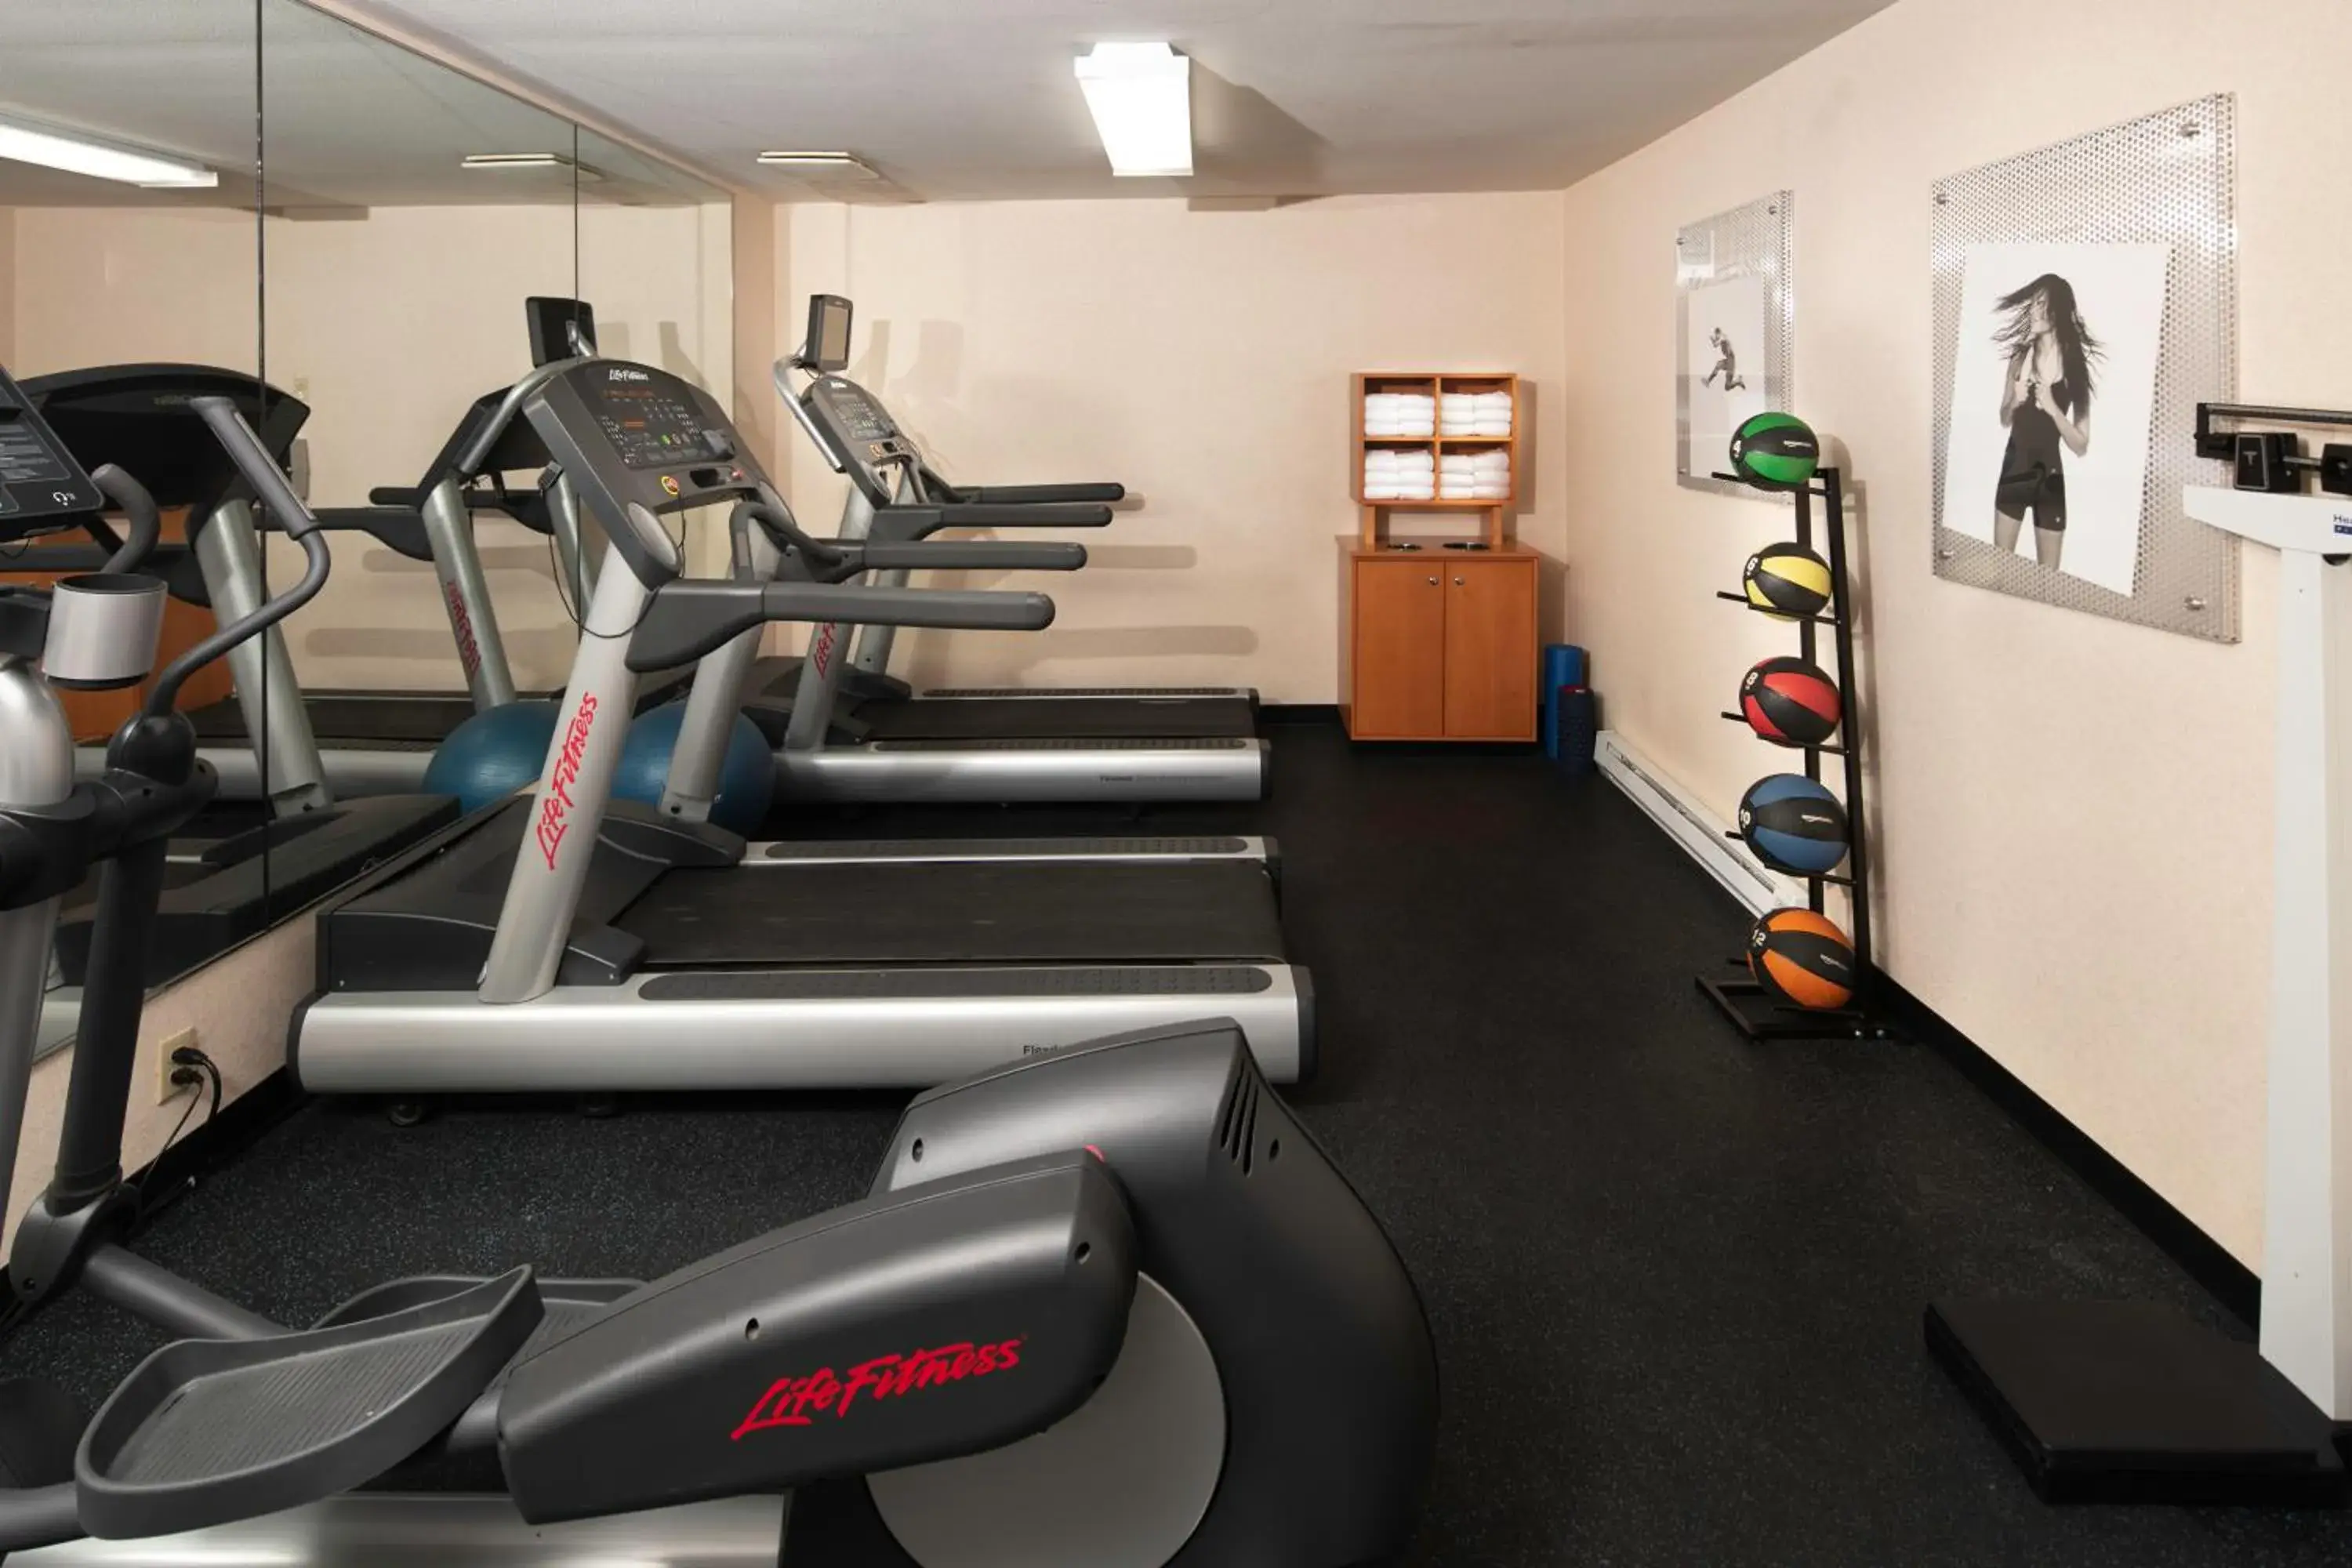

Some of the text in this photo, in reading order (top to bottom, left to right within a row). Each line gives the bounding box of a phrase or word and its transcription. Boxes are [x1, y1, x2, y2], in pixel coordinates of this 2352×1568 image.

[1747, 557, 1759, 572] 6
[1746, 671, 1759, 686] 8
[1740, 808, 1751, 826] 10
[1751, 928, 1766, 946] 12
